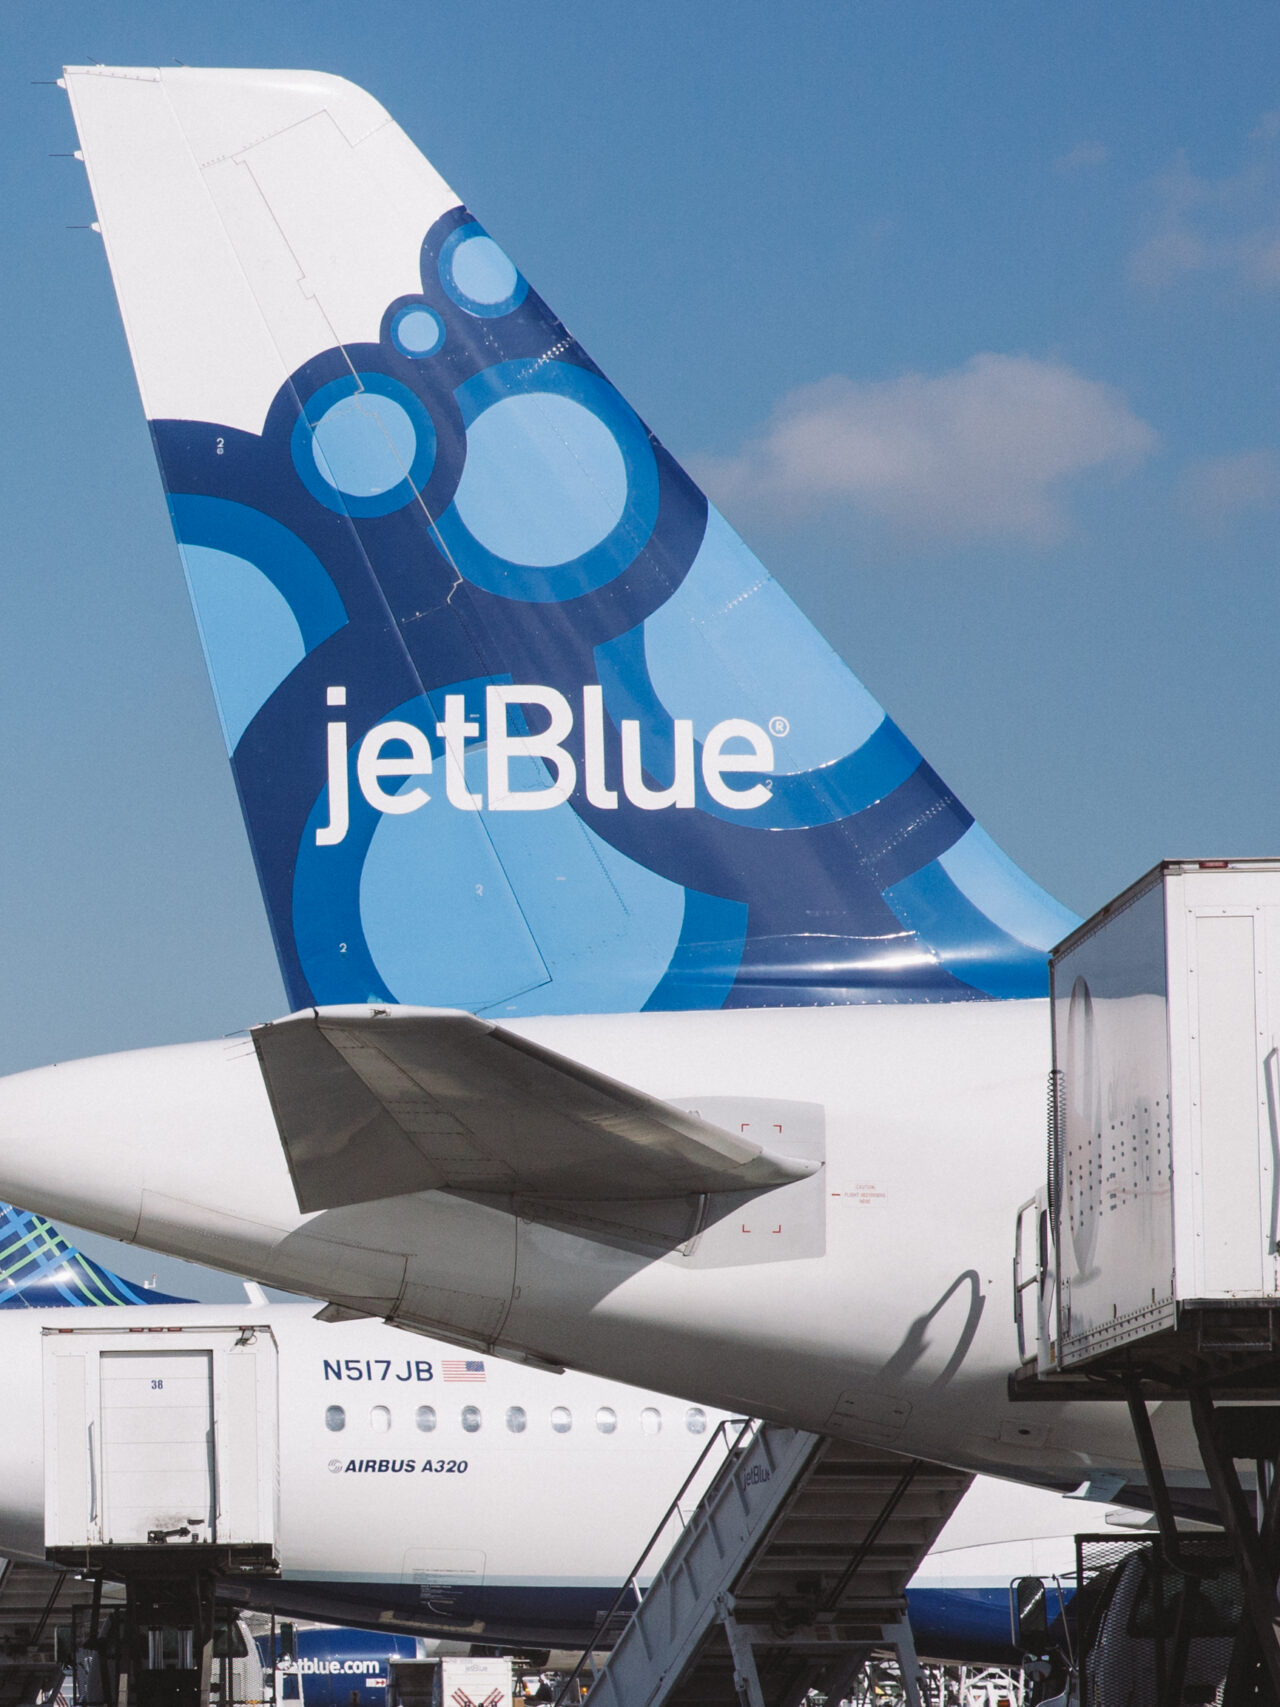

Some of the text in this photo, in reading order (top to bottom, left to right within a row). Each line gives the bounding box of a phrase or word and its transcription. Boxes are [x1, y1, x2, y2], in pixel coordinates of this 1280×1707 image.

[323, 1359, 434, 1382] N517JB
[151, 1379, 163, 1390] 38
[344, 1459, 469, 1474] AIRBUS A320
[293, 1657, 380, 1675] tblue.com
